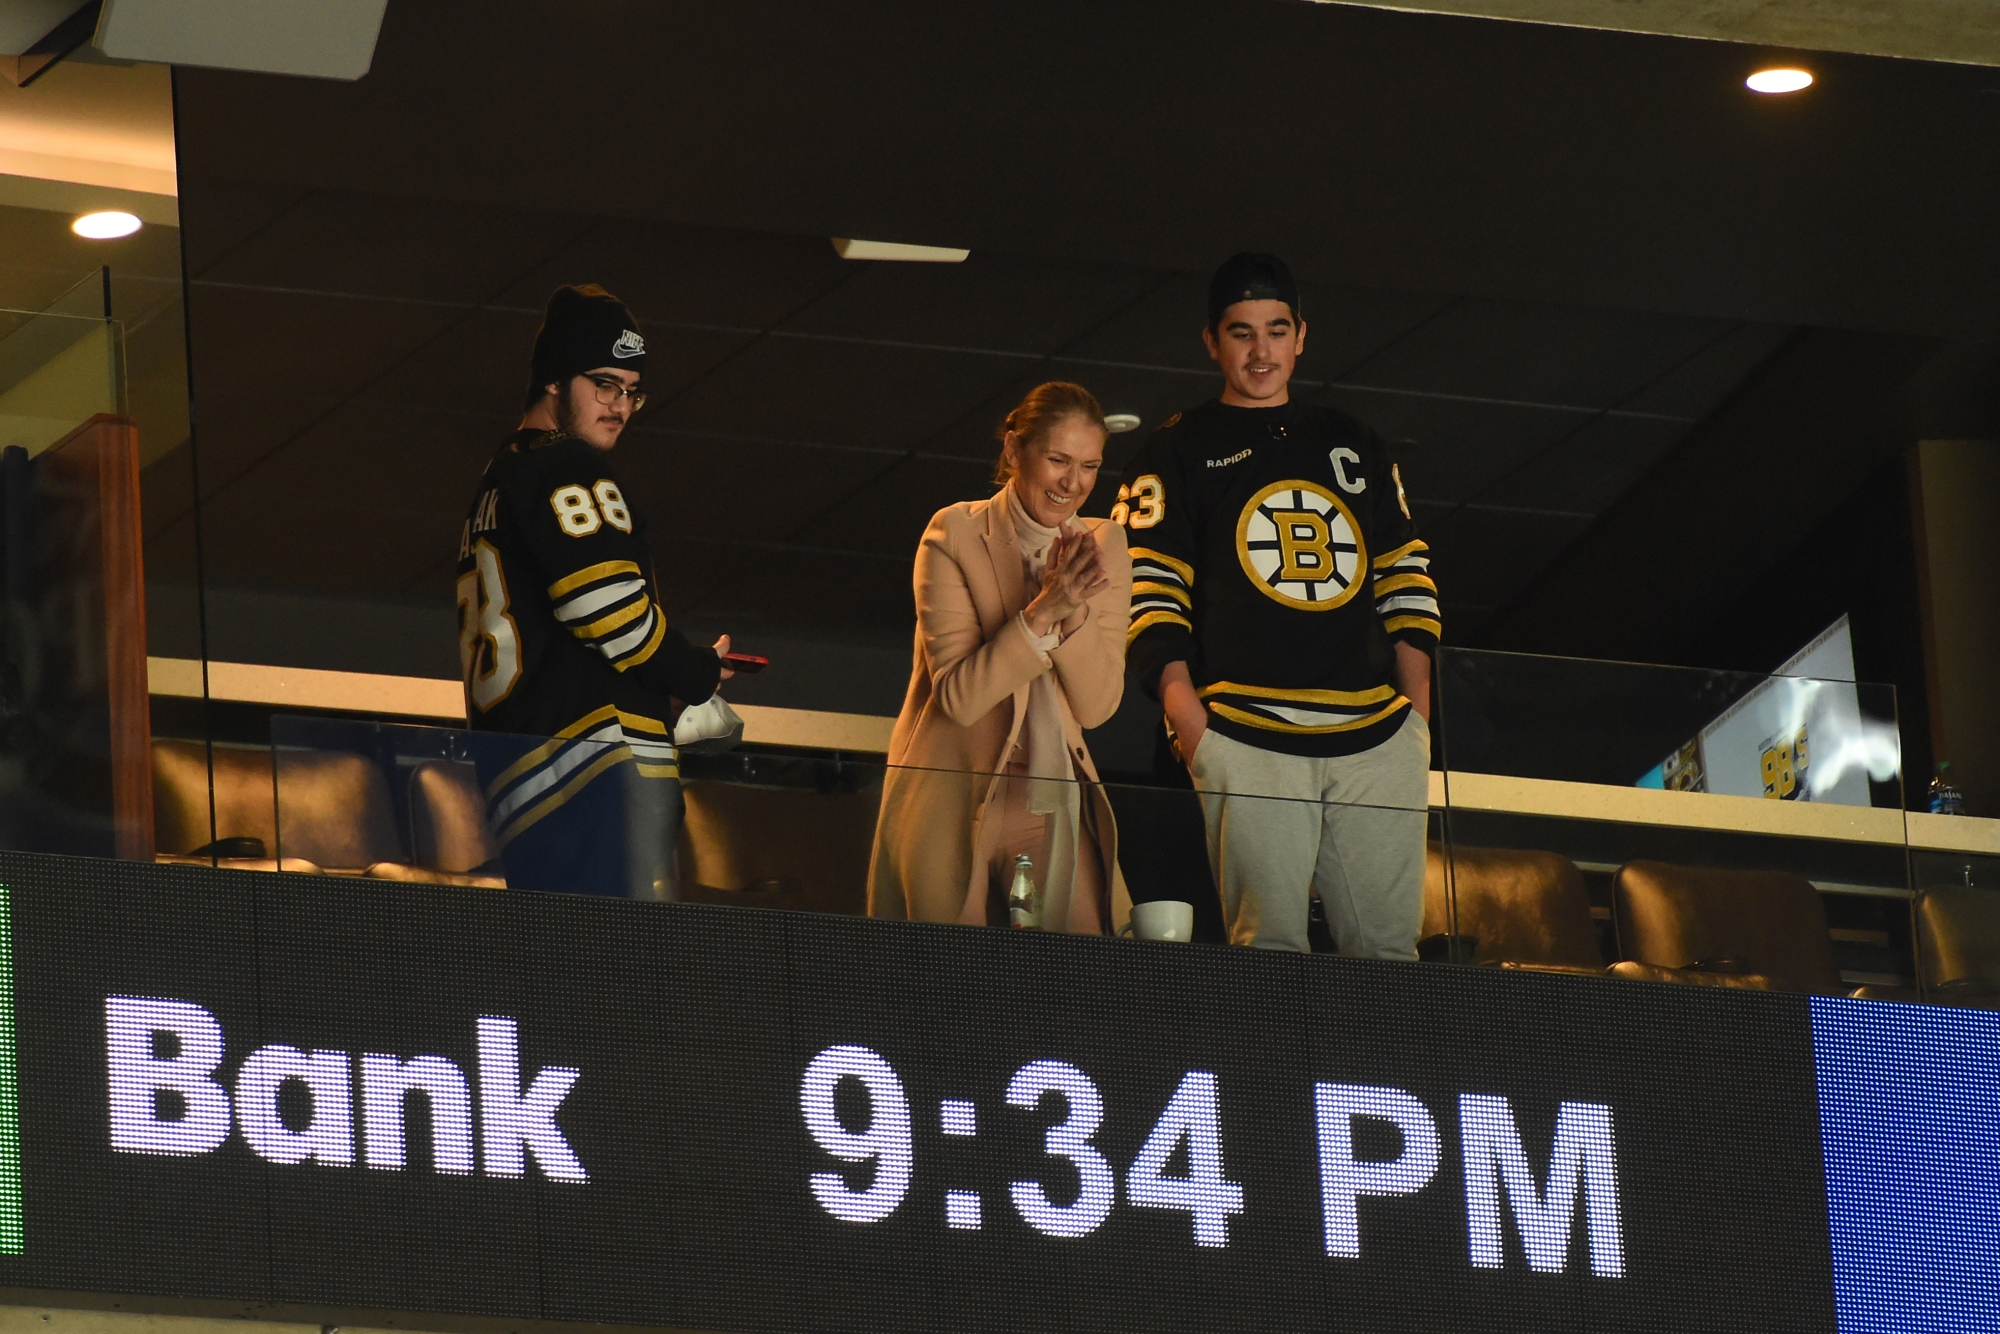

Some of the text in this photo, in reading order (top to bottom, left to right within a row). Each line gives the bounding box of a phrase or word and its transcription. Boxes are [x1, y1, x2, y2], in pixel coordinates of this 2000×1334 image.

[1329, 447, 1366, 494] C
[551, 479, 632, 537] 88
[1272, 511, 1334, 581] B
[106, 993, 590, 1184] Bank
[799, 1045, 1627, 1279] 9:34 PM
